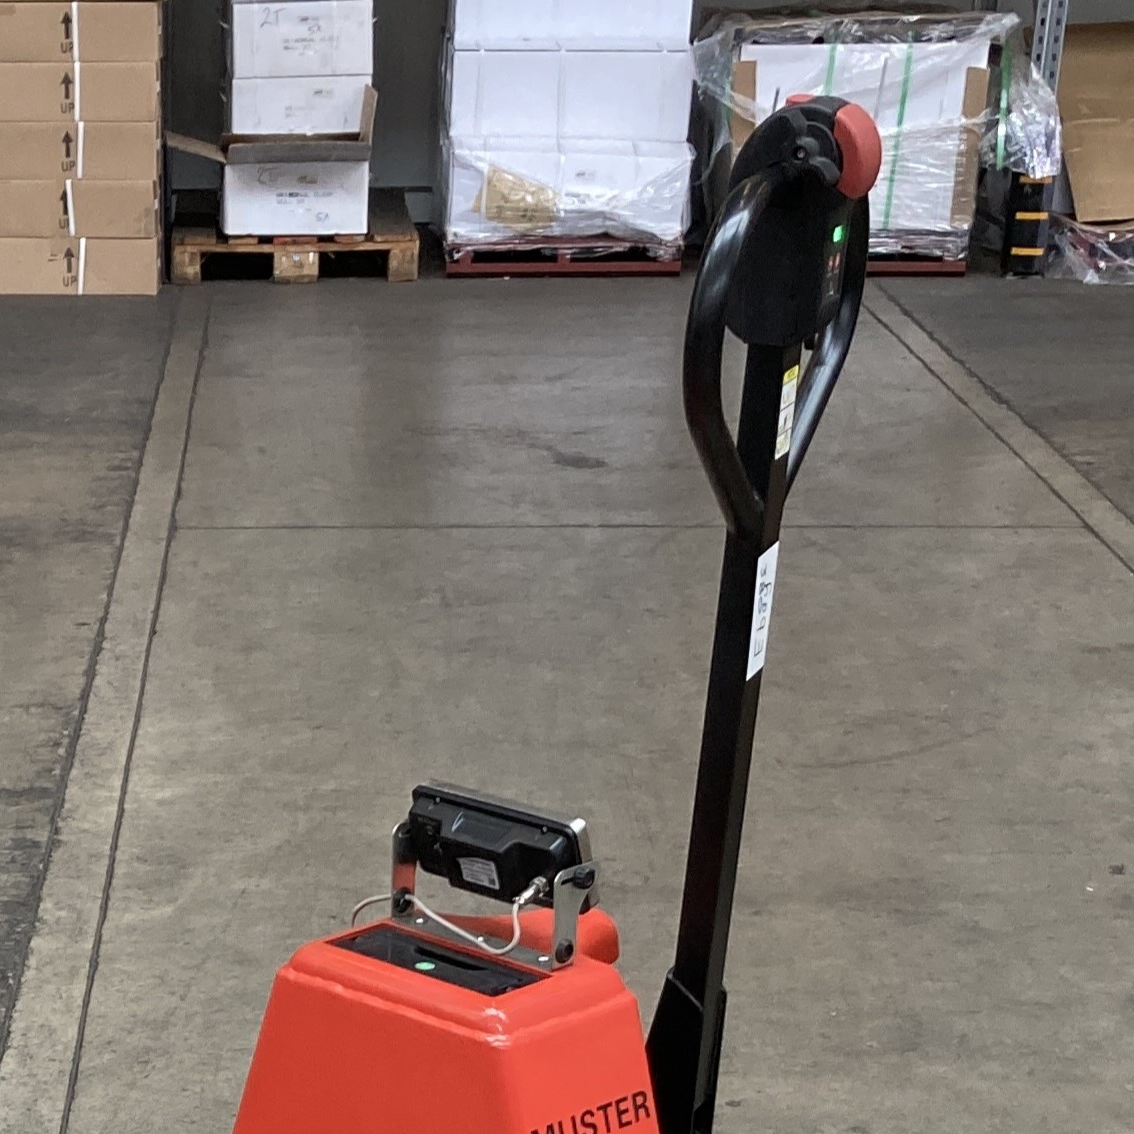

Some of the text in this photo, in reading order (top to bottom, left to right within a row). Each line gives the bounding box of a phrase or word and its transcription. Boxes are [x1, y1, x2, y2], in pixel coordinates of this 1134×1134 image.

[60, 41, 74, 54] UP
[60, 102, 75, 114] UP
[61, 160, 76, 172] UP
[62, 275, 77, 287] UP
